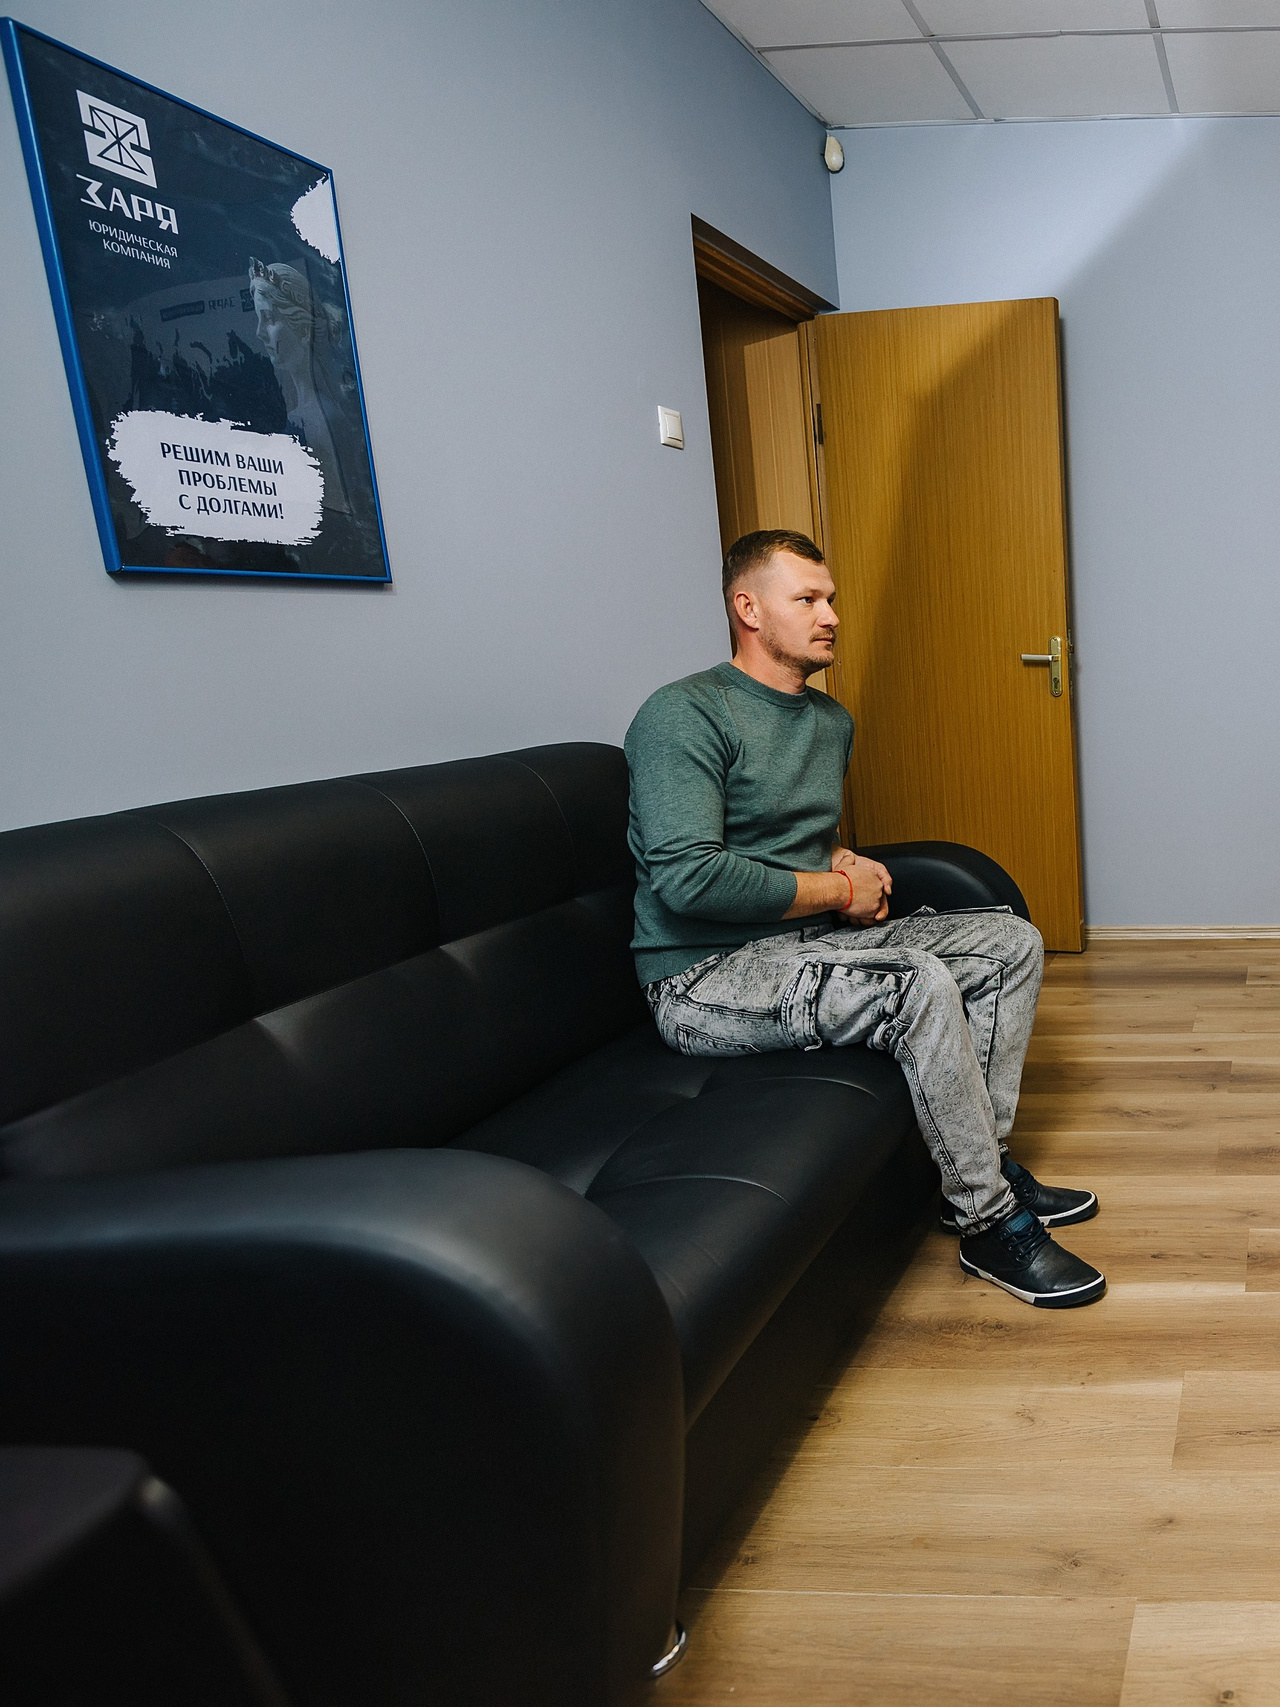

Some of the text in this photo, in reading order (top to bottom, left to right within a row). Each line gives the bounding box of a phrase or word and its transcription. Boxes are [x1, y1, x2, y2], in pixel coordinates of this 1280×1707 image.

[76, 173, 179, 235] ЗАРЯ
[88, 219, 178, 258] ЮРИДИЧЕСКАЯ
[102, 238, 171, 269] КОМПАНИЯ
[160, 442, 285, 476] РЕШИМ ВАШИ
[178, 469, 278, 496] ПРОБЛЕМЫ
[178, 493, 285, 520] С ДОЛГАМИ!
